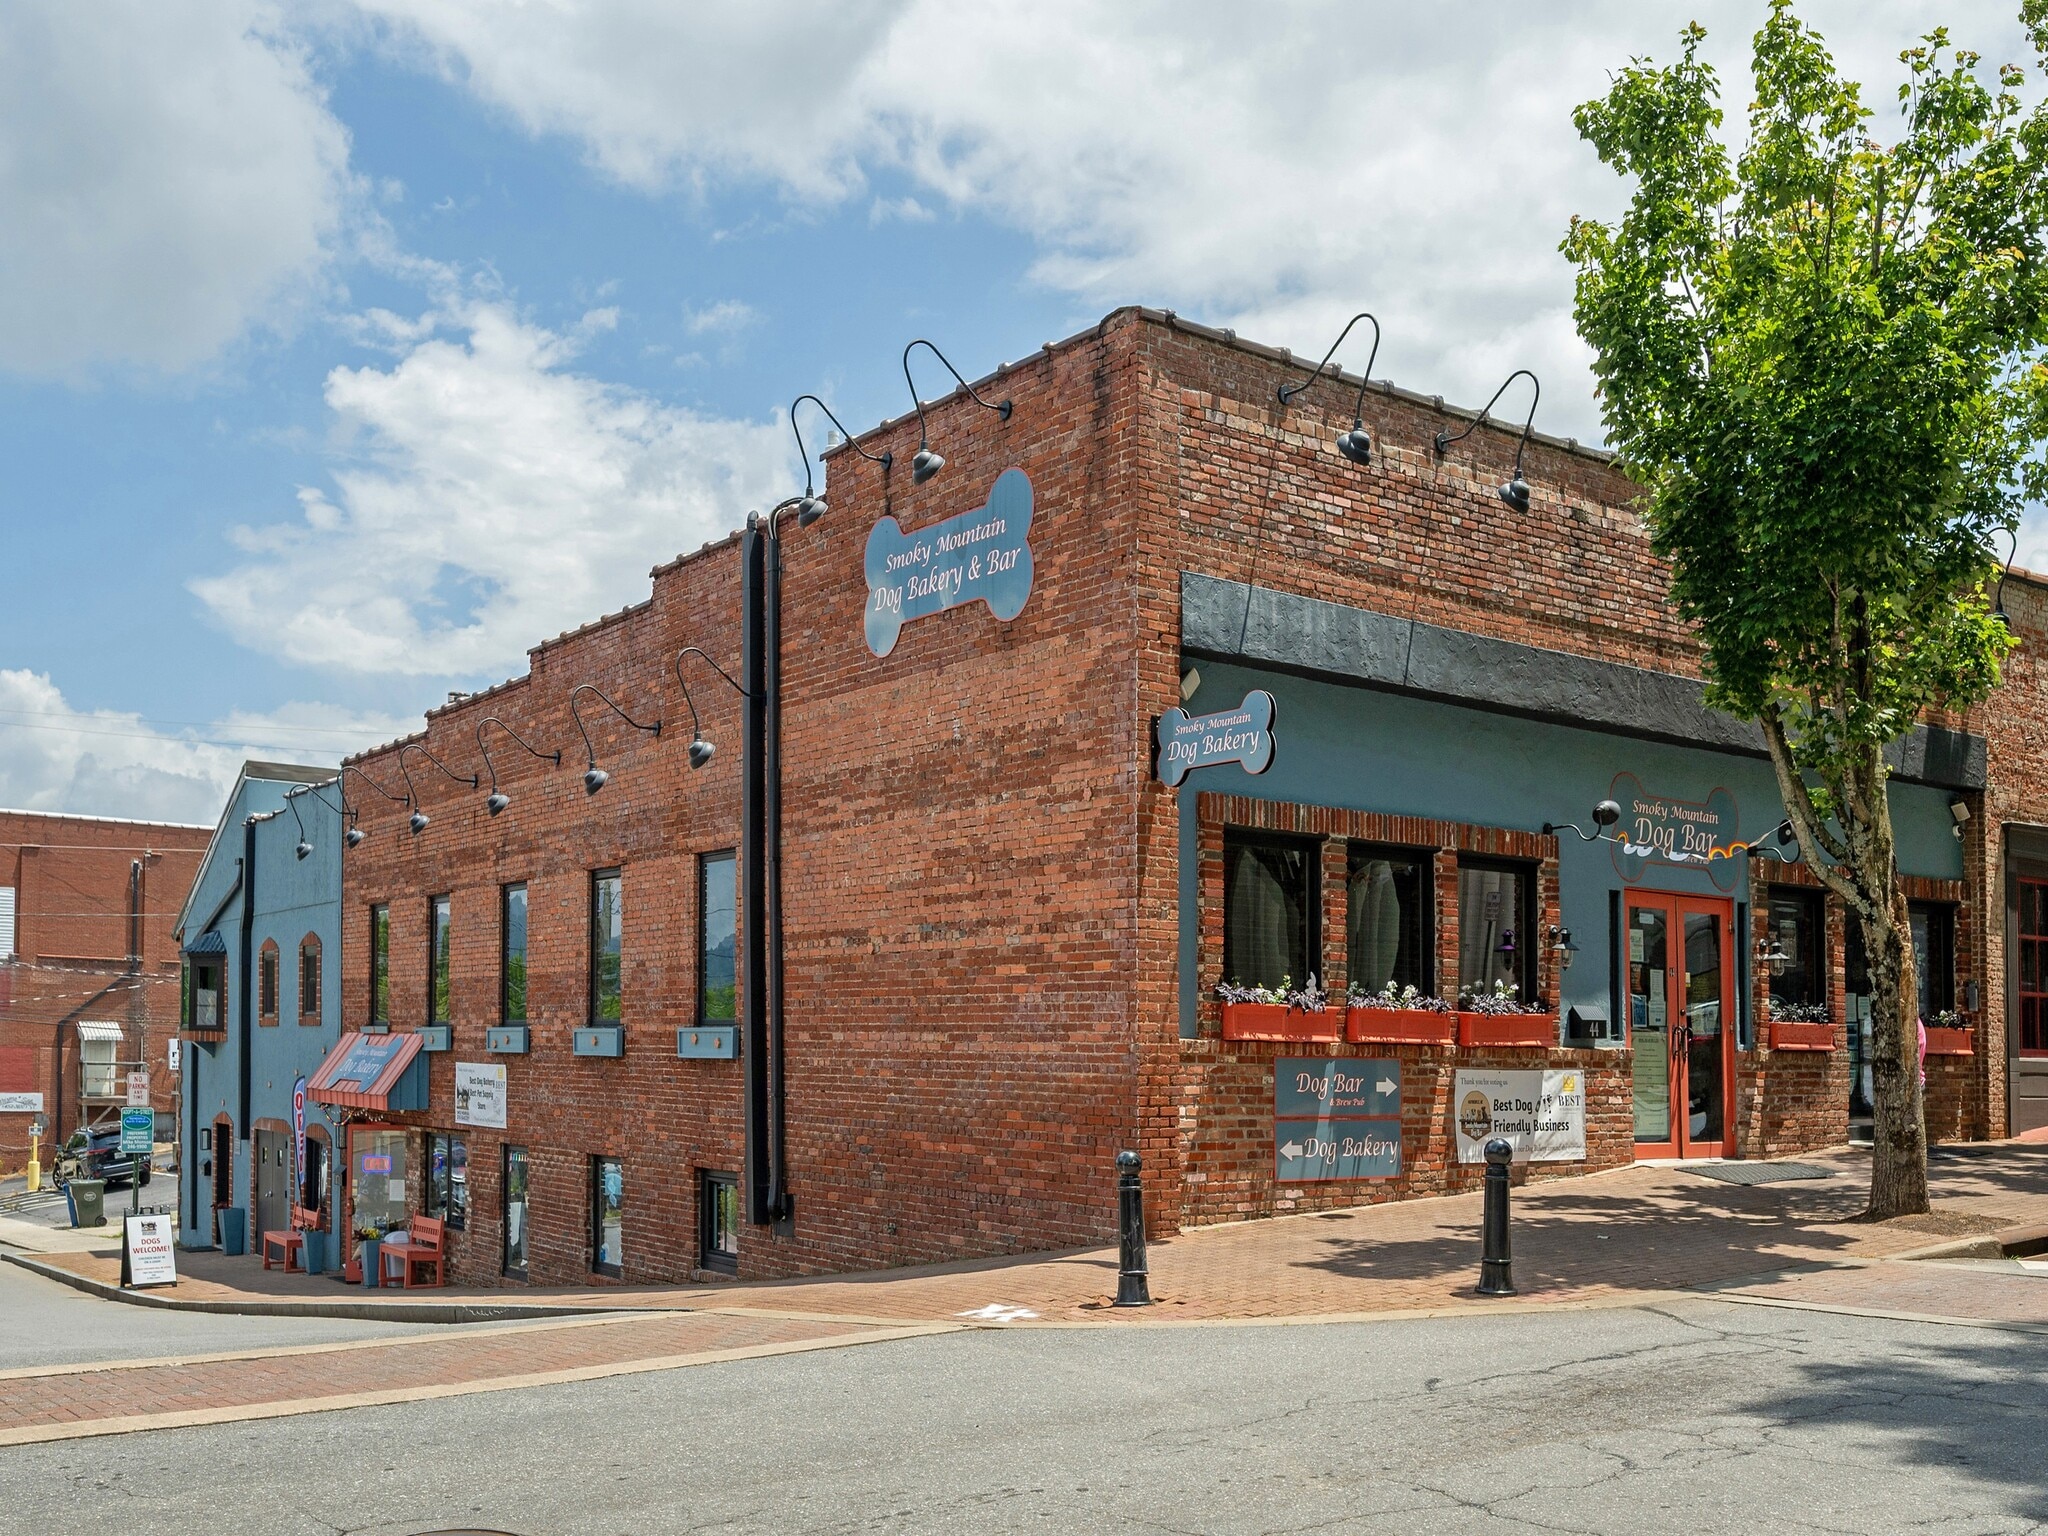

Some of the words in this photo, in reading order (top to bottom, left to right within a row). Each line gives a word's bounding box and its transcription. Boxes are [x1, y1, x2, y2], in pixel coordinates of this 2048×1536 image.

[885, 541, 931, 573] Smoky
[935, 516, 1006, 556] Mountain
[874, 586, 903, 614] Dog
[907, 565, 963, 600] Bakery
[968, 555, 981, 580] &
[987, 548, 1021, 575] Bar
[1175, 720, 1205, 736] Smoky
[1207, 712, 1251, 730] Mountain
[1167, 741, 1198, 765] Dog
[1202, 728, 1260, 755] Bakery
[1632, 799, 1668, 821] Smoky
[1671, 806, 1719, 825] Mountain
[1635, 817, 1675, 859] Dog
[1681, 824, 1718, 857] Bar
[1590, 1021, 1599, 1037] 44
[1296, 1072, 1329, 1100] Dog
[1333, 1073, 1364, 1093] Bar
[1460, 1077, 1474, 1085] Thank
[1490, 1079, 1503, 1087] voting
[1493, 1099, 1513, 1111] Best
[1515, 1099, 1533, 1114] Dog
[1558, 1095, 1580, 1106] BEST
[1494, 1119, 1531, 1135] Friendly
[1533, 1120, 1570, 1132] Business
[1304, 1138, 1337, 1165] Dog
[1342, 1134, 1398, 1163] Bakery
[132, 1245, 170, 1254] WELCOME!
